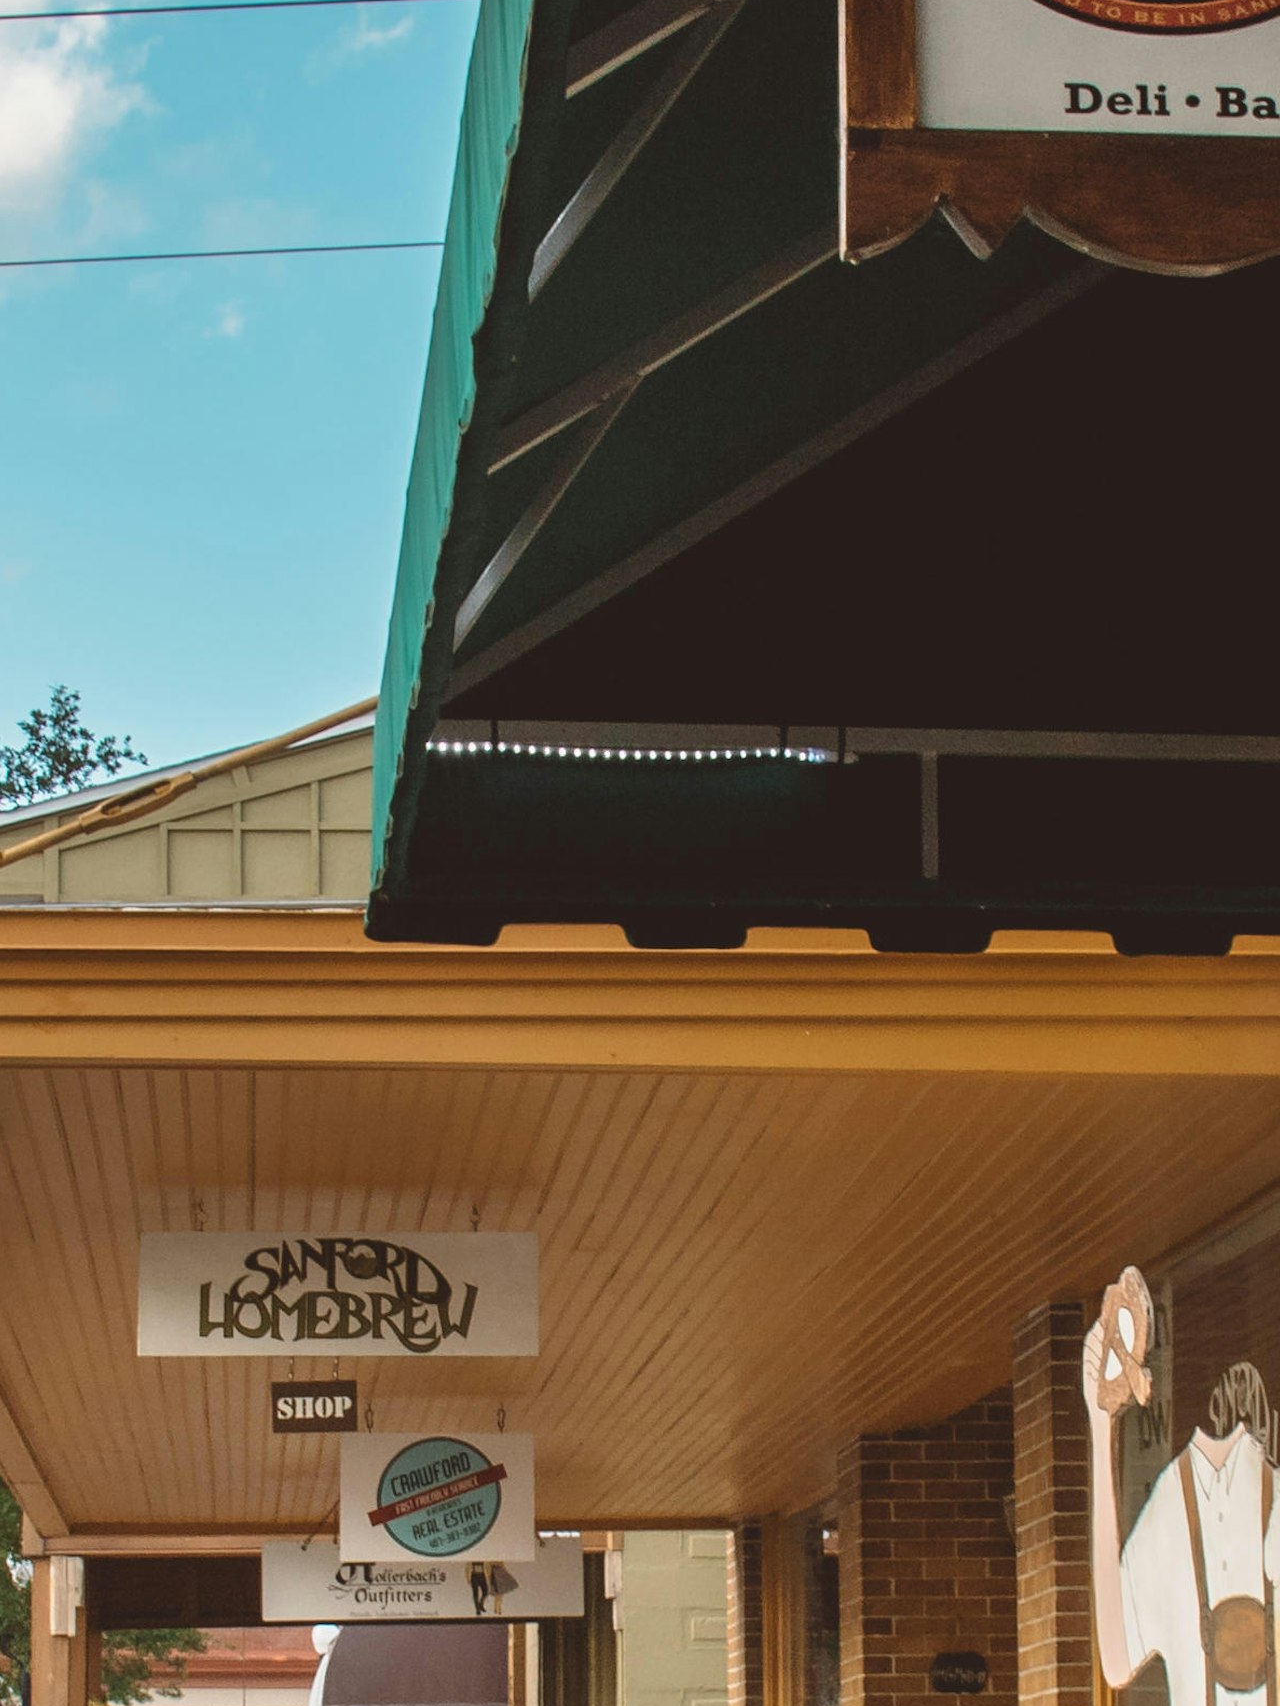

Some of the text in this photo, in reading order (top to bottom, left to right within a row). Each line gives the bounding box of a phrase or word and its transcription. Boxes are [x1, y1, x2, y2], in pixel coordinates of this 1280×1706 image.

[1092, 1, 1122, 22] TO
[1133, 9, 1167, 27] BE
[1178, 9, 1207, 27] IN
[1062, 82, 1172, 119] Deli
[230, 1237, 453, 1305] SANFORD
[198, 1281, 479, 1354] HOMEBREW
[276, 1395, 354, 1421] SHOP
[390, 1451, 472, 1497] CRAWFORD
[411, 1517, 441, 1542] REAL
[443, 1501, 486, 1529] ESTATE
[354, 1586, 433, 1610] Outfitters
